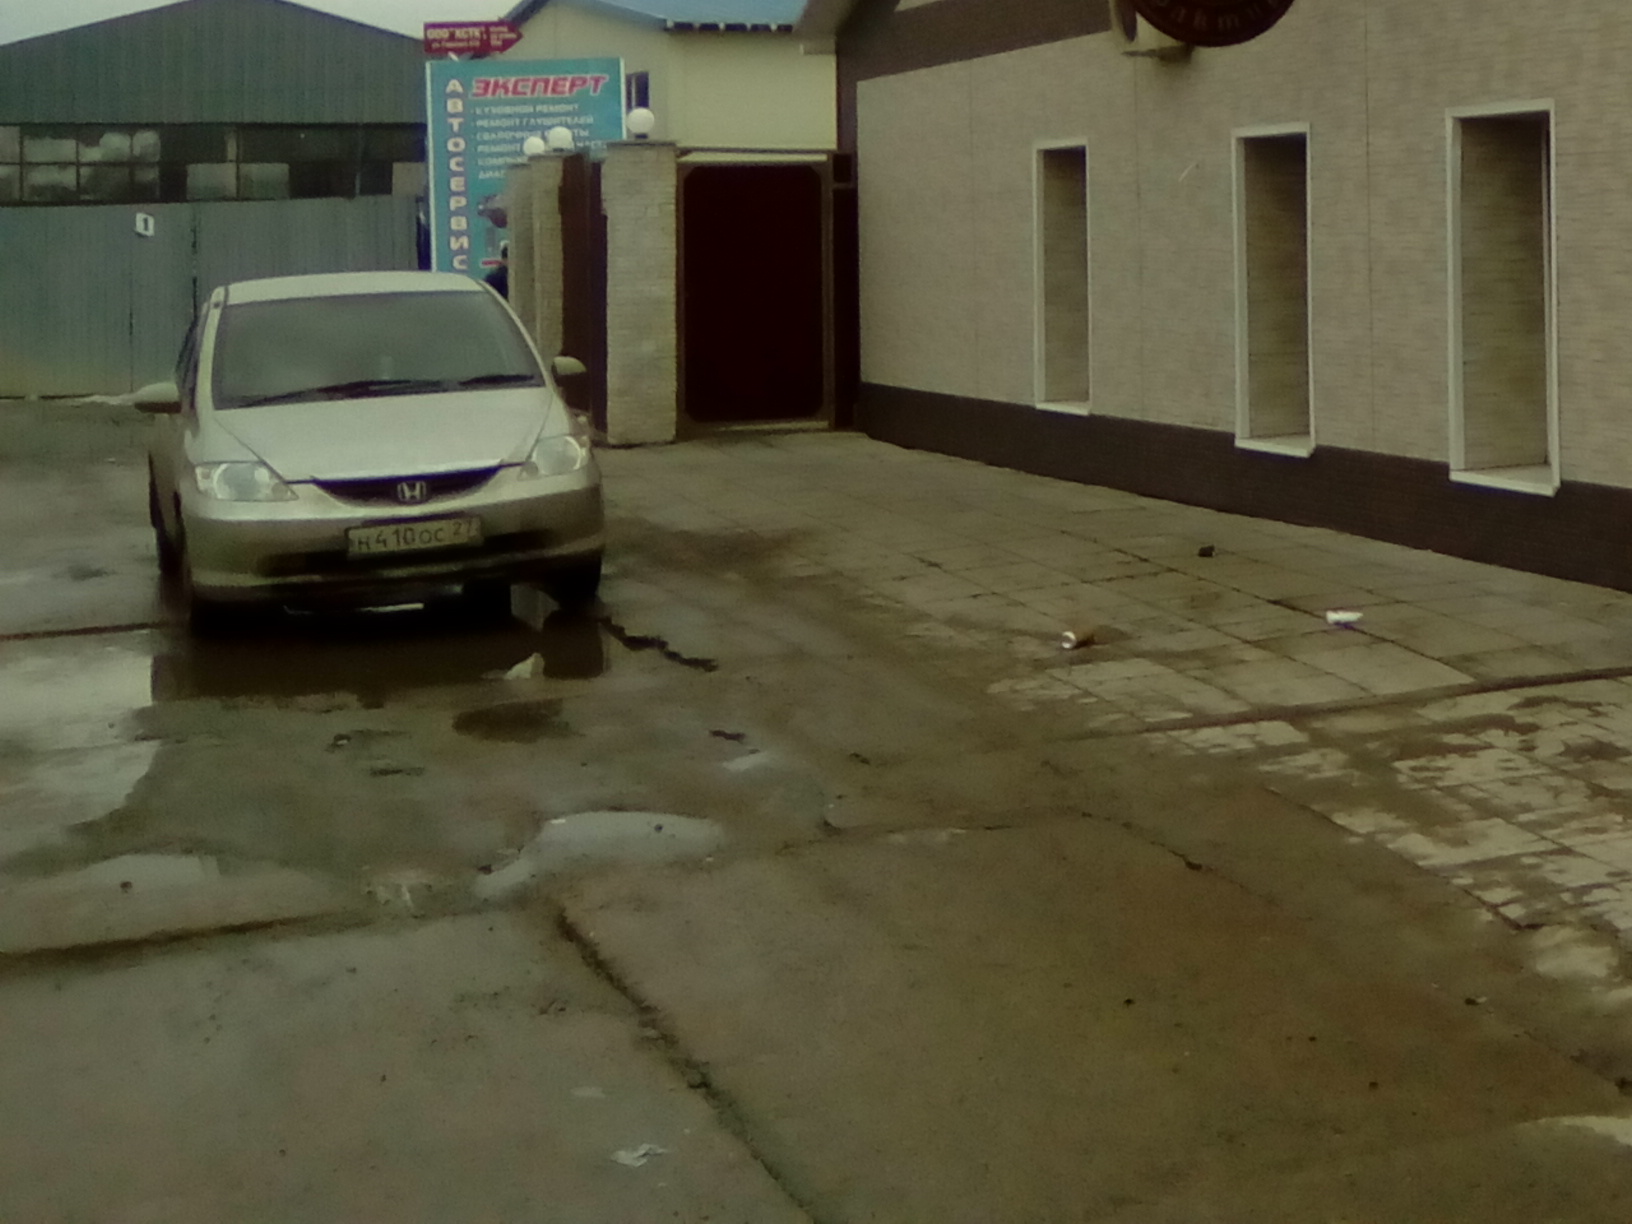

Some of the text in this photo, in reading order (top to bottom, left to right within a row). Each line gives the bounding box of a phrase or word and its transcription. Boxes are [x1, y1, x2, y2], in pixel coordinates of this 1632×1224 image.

[470, 74, 609, 98] ЭКСПЕРТ
[536, 103, 579, 114] РЕМОНТ
[476, 117, 521, 128] РЕМОНТ
[445, 78, 469, 270] АВТОСЕРВИС
